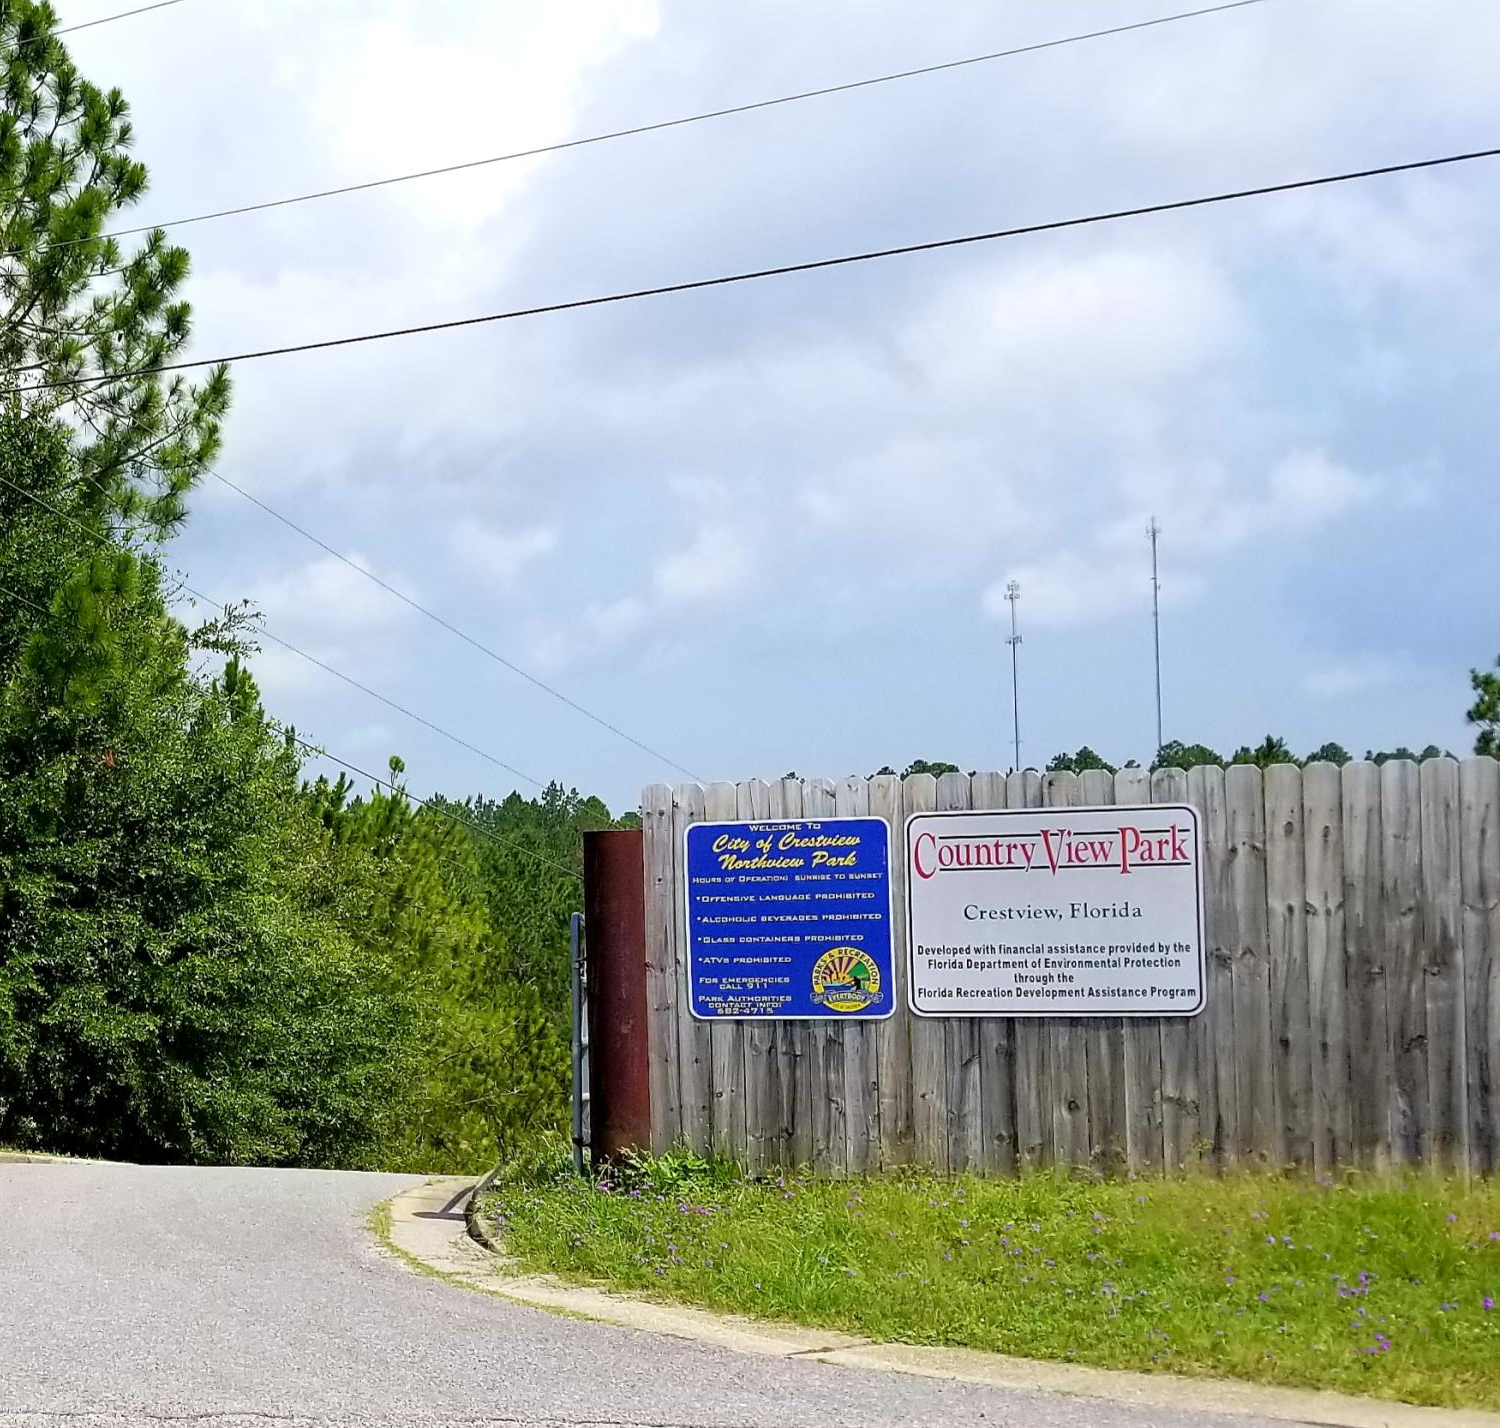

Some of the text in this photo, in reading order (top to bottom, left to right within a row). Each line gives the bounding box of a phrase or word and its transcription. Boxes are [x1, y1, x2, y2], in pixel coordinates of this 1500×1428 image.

[712, 833, 861, 853] City of Crestview
[914, 824, 1190, 879] Country View Park
[718, 851, 858, 870] Northview Park
[964, 902, 1142, 921] Crestview, Florida
[917, 942, 1191, 957] Developed with financial assistance provided by the
[813, 959, 828, 986] PARKS
[837, 949, 879, 985] RECREATION
[928, 957, 1181, 971] Florida Department of Environmental Protection
[1014, 973, 1075, 985] through the
[699, 995, 726, 1003] PARK
[918, 986, 1196, 999] Florida Recreation Development Assistance Program
